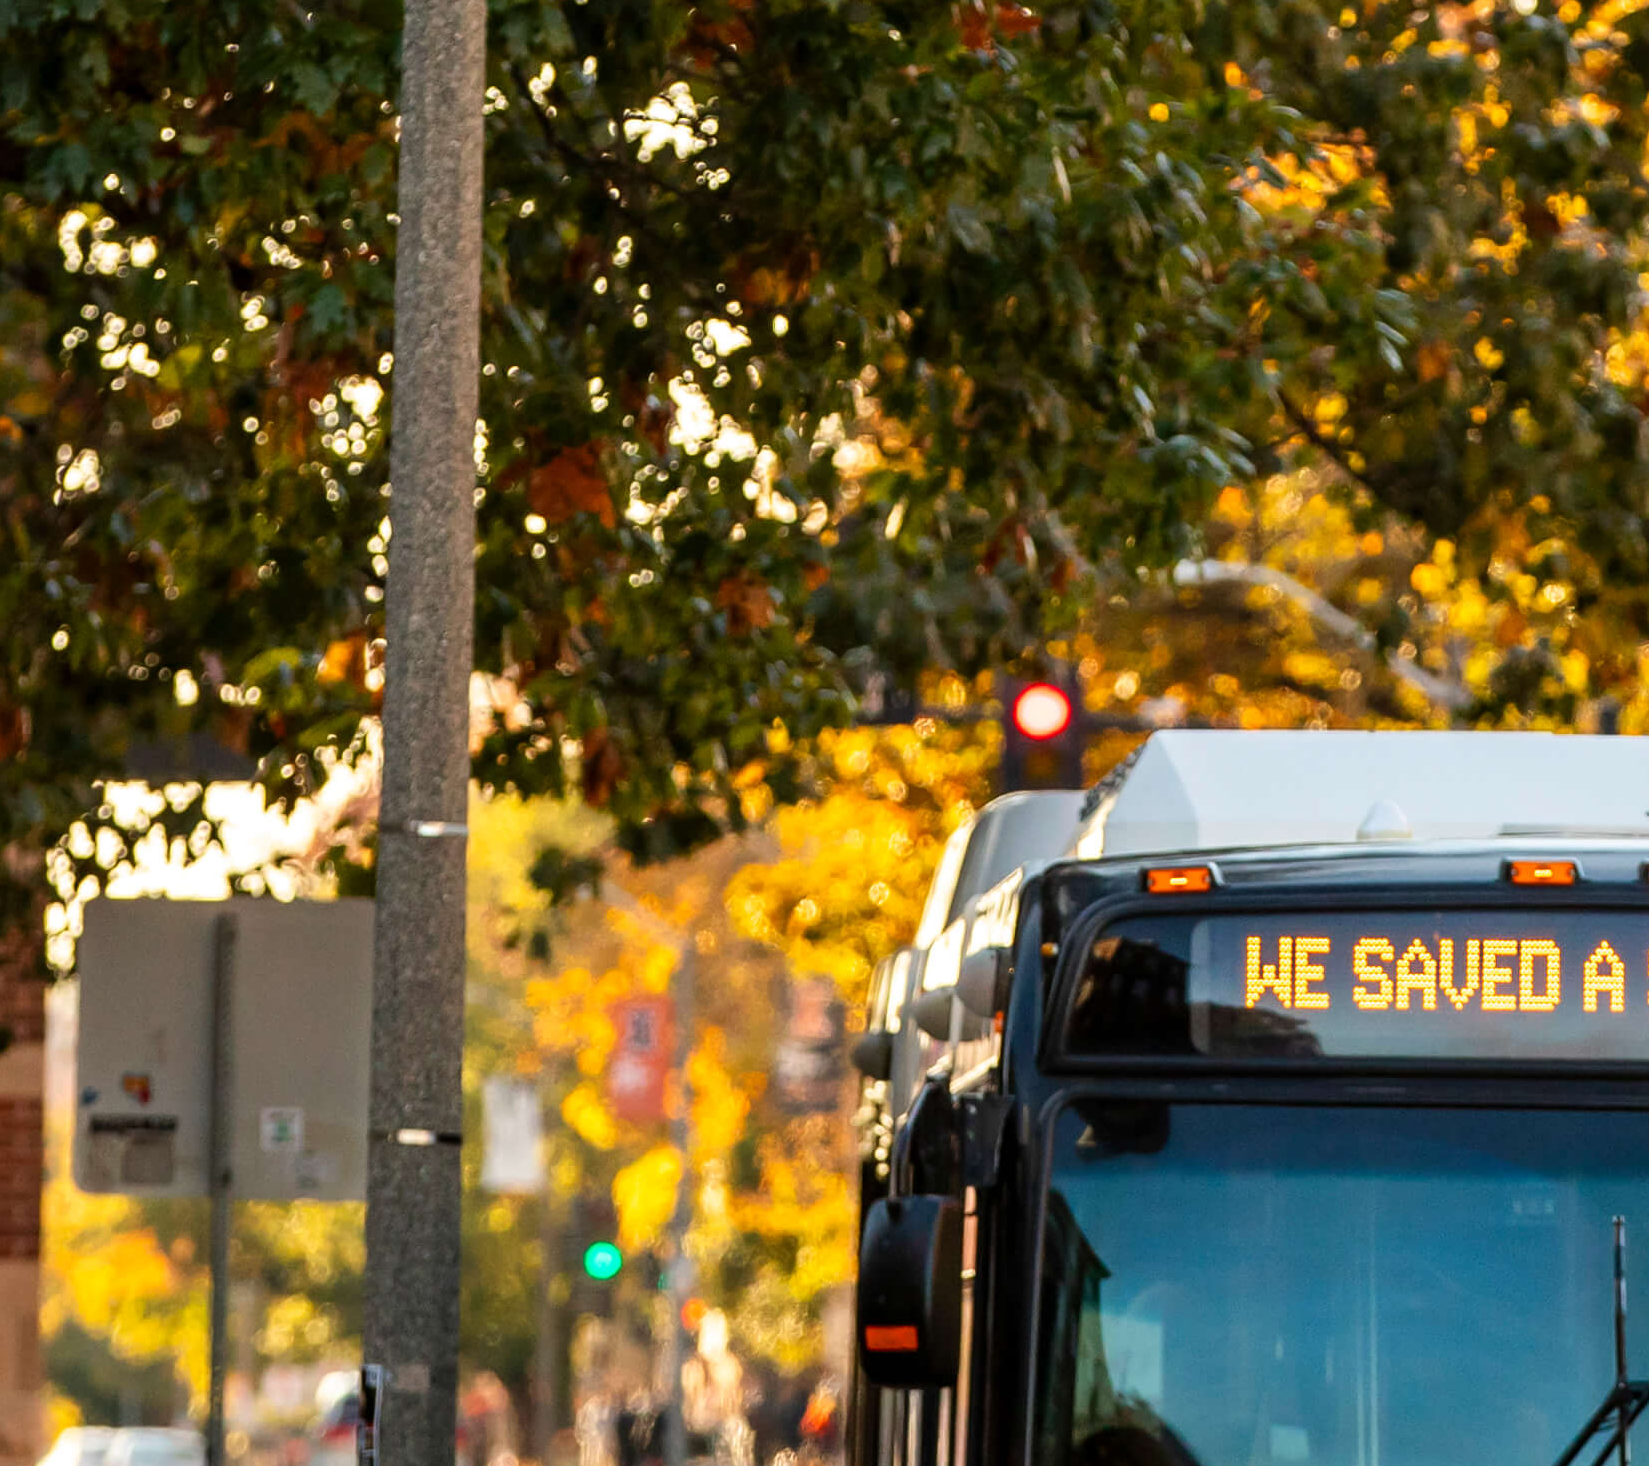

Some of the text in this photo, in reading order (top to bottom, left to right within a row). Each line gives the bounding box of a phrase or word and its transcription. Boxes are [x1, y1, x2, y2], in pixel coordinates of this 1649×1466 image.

[1244, 936, 1331, 1010] WE
[1352, 937, 1561, 1012] SAVED
[1582, 939, 1626, 1013] A
